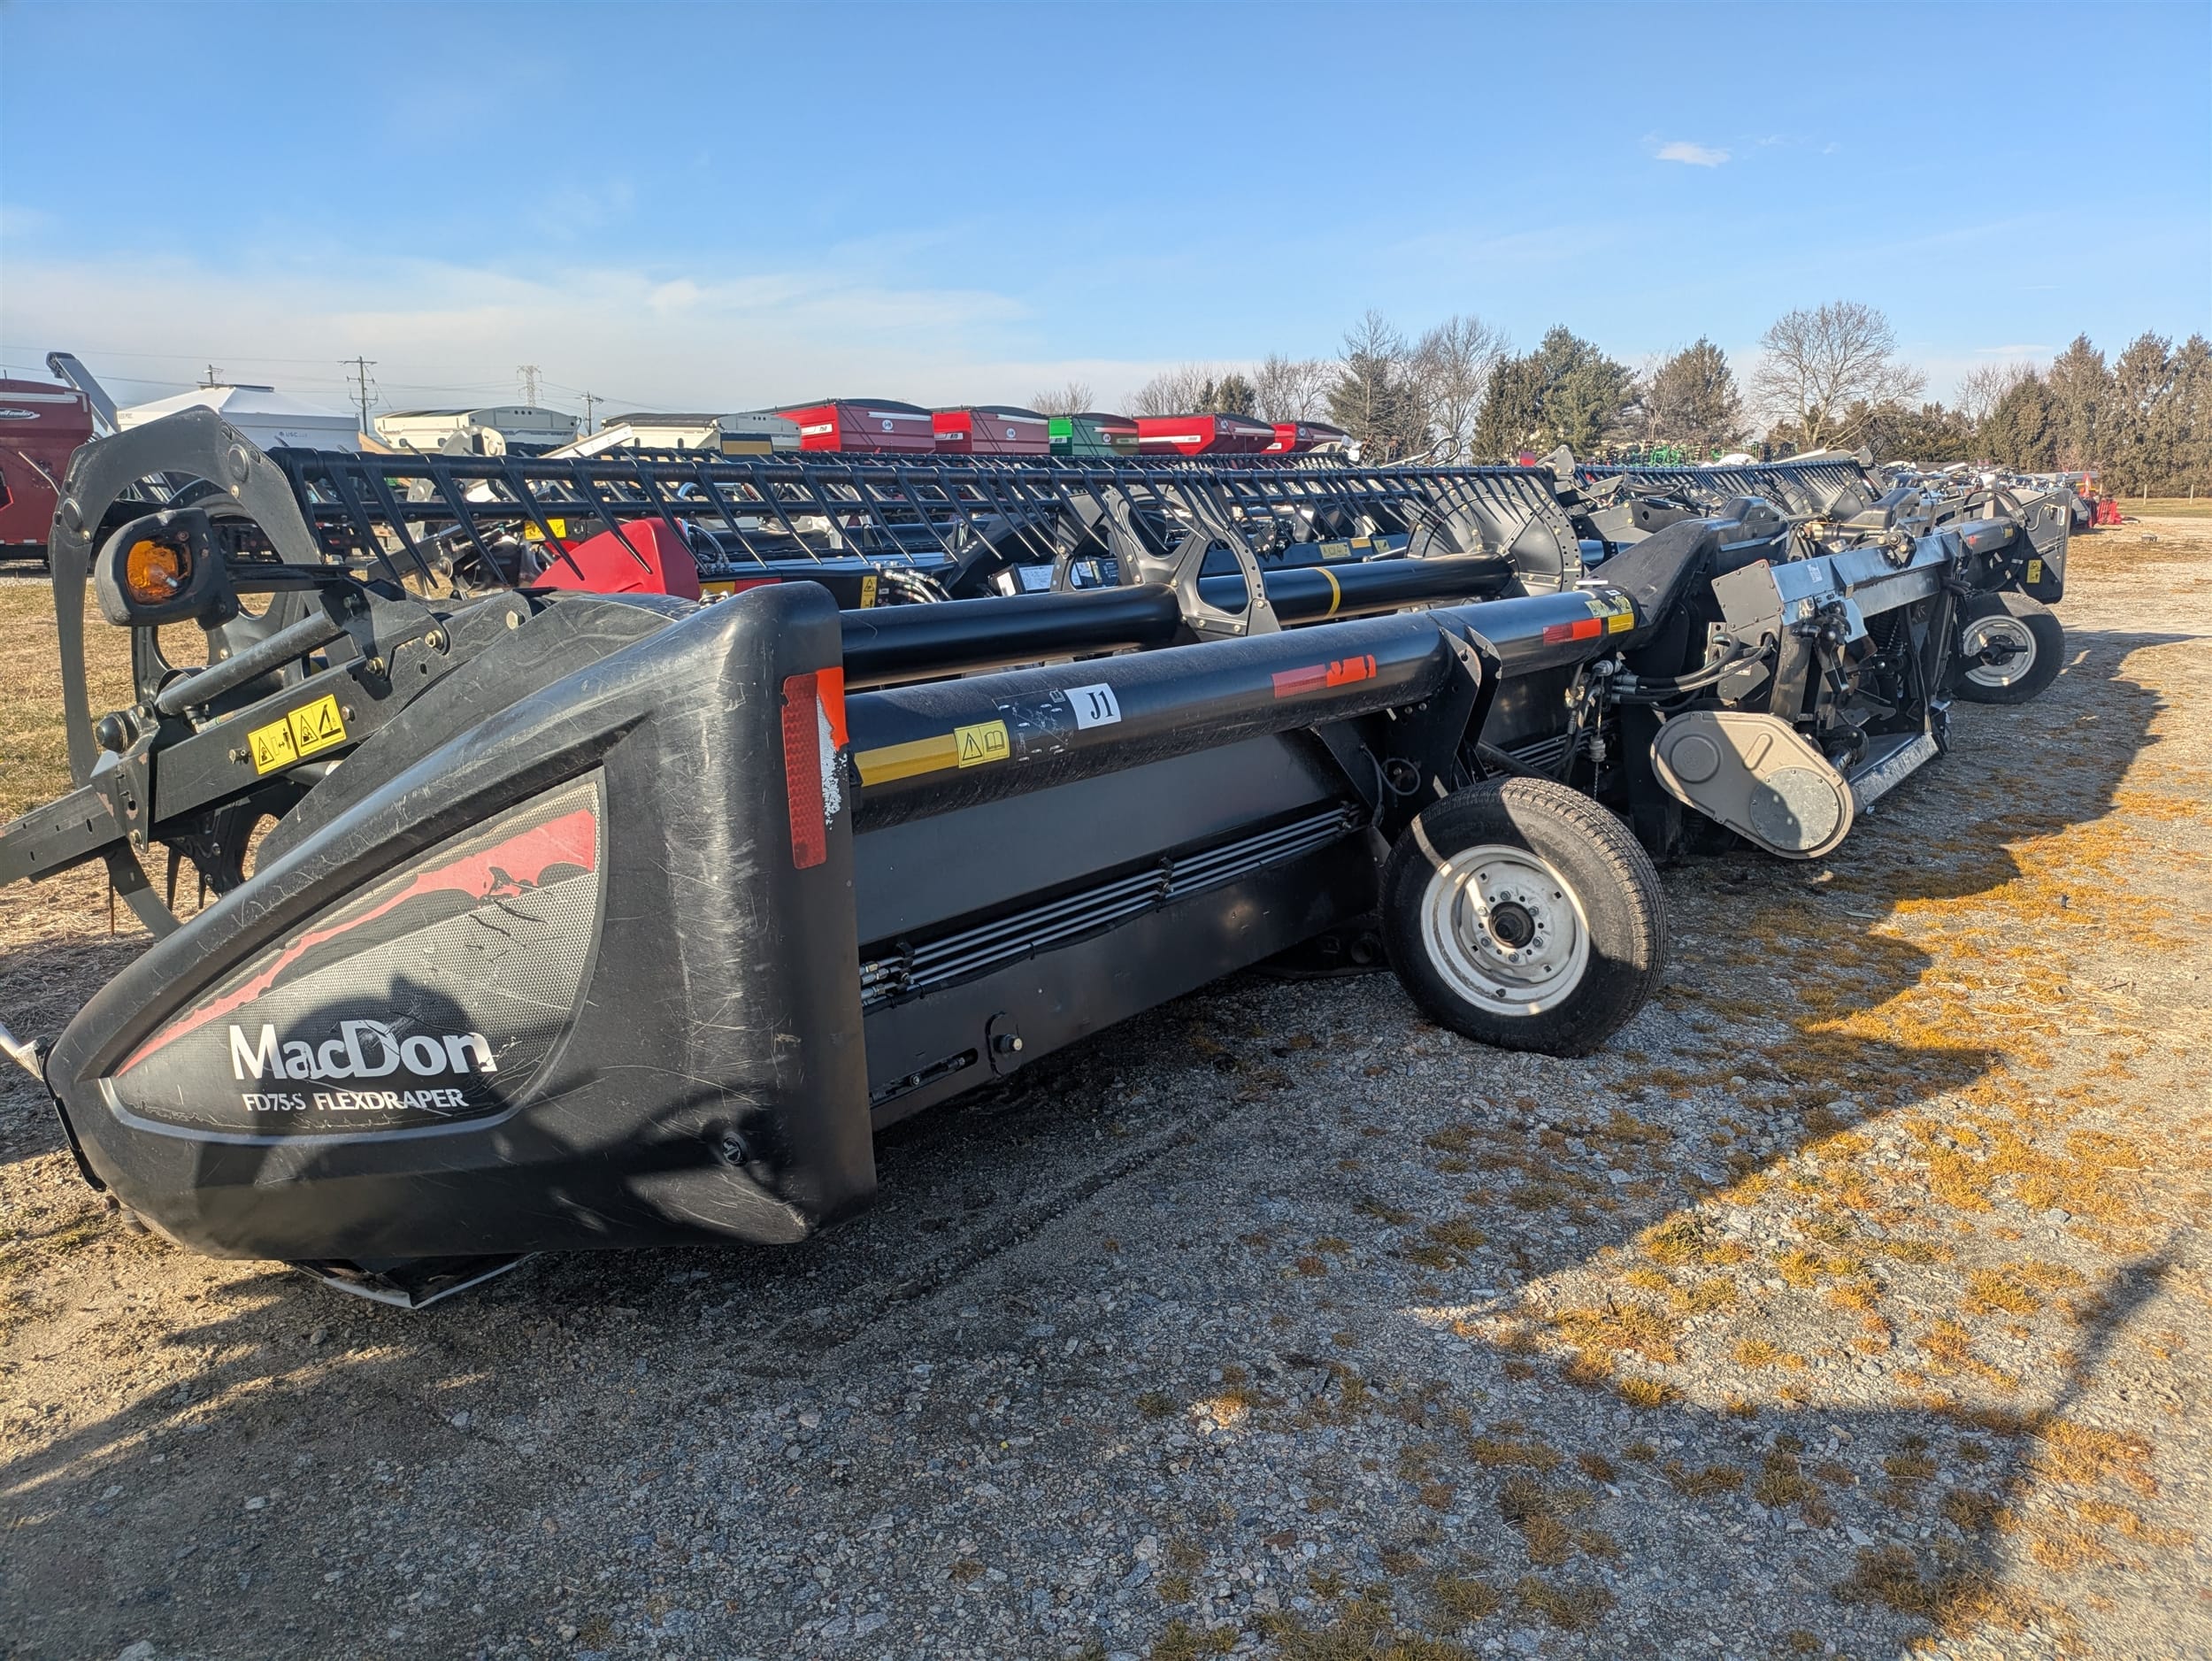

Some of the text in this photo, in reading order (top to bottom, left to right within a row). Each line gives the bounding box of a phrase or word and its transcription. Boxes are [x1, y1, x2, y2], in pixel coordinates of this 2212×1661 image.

[1087, 689, 1115, 720] J1
[228, 1019, 499, 1080] MacDon
[312, 1088, 470, 1111] FLEXDRAPER
